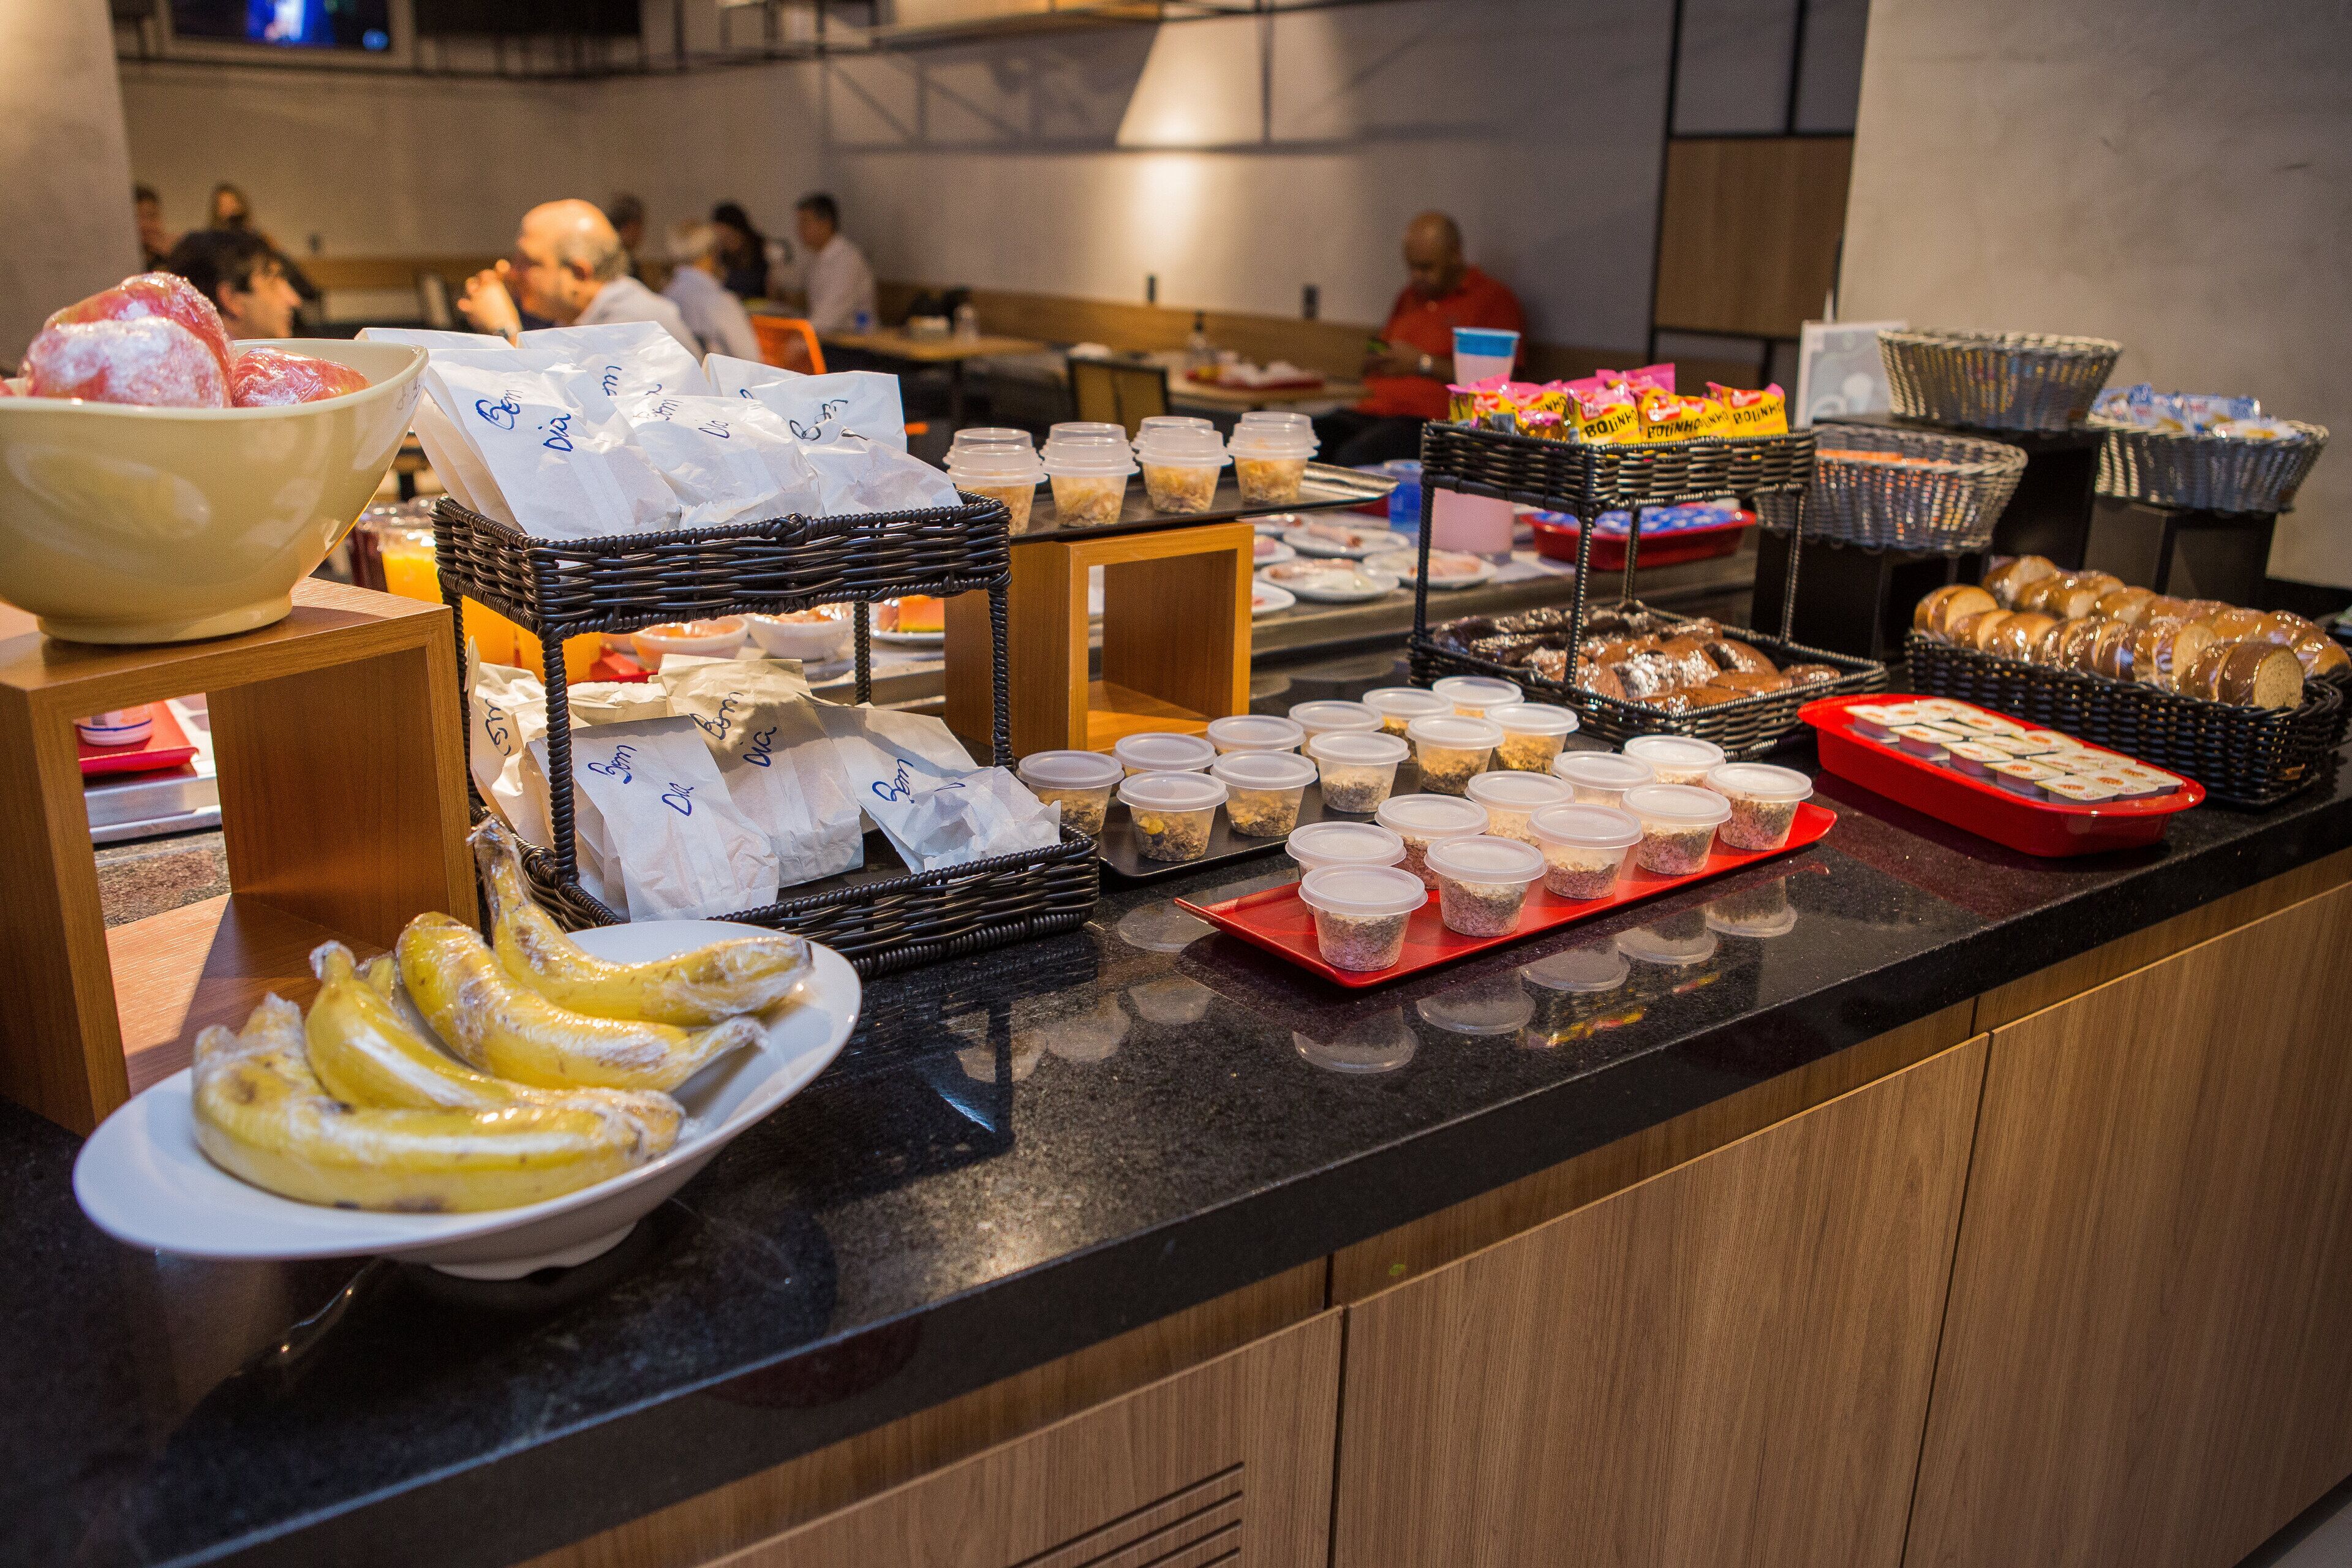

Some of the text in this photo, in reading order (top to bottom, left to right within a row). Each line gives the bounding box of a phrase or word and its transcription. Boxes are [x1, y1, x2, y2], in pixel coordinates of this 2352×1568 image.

[537, 413, 574, 452] Dia
[689, 692, 744, 740] Bom
[740, 726, 777, 767] Dia
[661, 782, 695, 816] Dia
[872, 758, 914, 804] Bom
